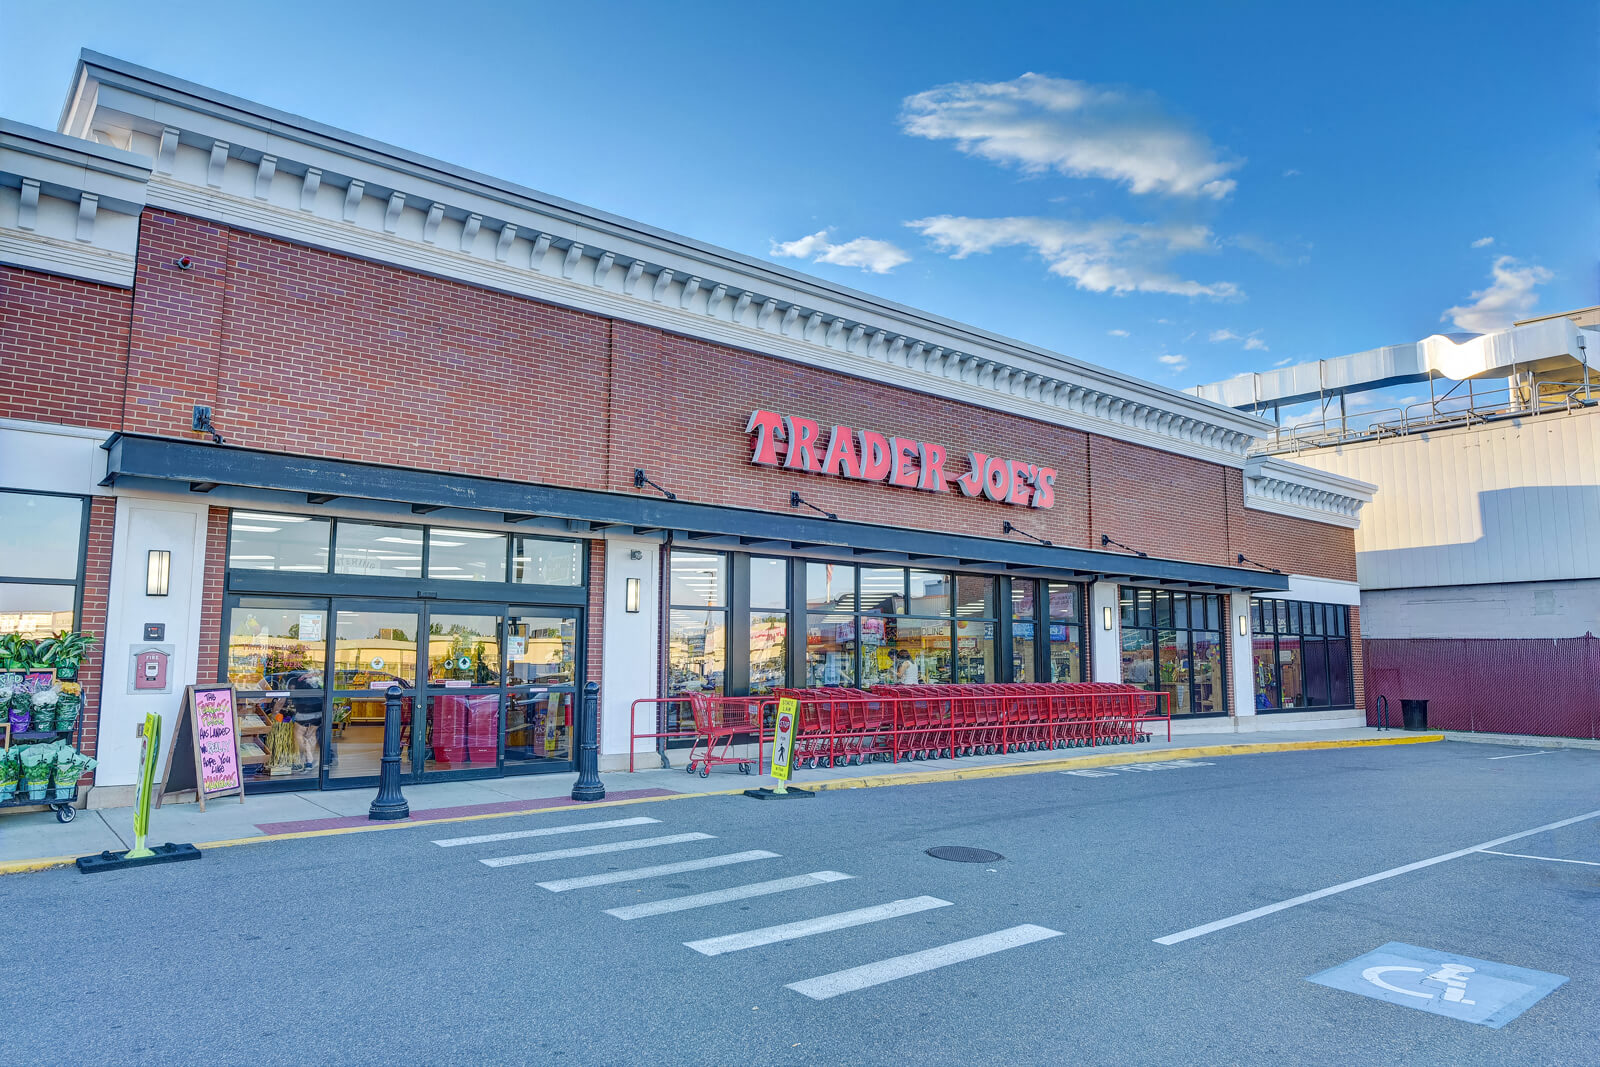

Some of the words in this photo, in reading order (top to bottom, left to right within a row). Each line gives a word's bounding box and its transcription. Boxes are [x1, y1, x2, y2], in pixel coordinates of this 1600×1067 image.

[745, 410, 950, 491] TRADER
[956, 452, 1057, 509] JOE'S
[779, 720, 791, 728] STOP
